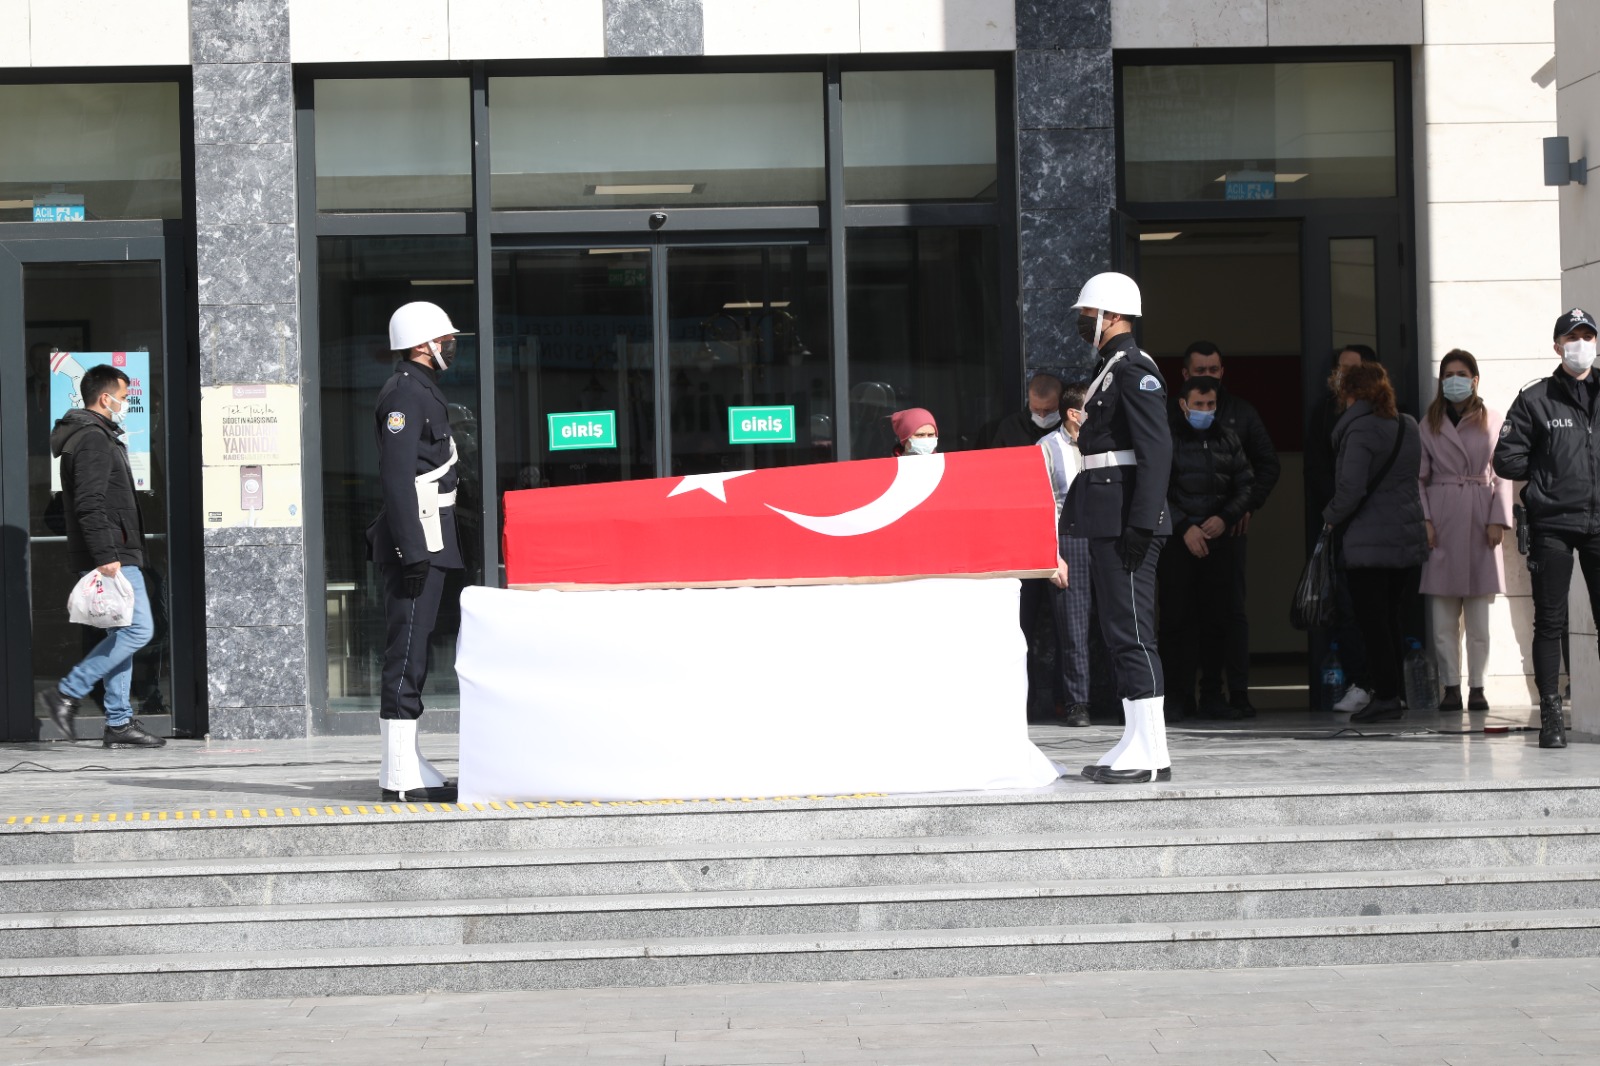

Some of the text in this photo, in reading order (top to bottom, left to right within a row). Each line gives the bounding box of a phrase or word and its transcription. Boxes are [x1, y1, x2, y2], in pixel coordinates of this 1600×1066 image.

[561, 421, 604, 438] GİRİŞ
[741, 415, 783, 433] GİRİŞ
[223, 436, 279, 454] YANINDA
